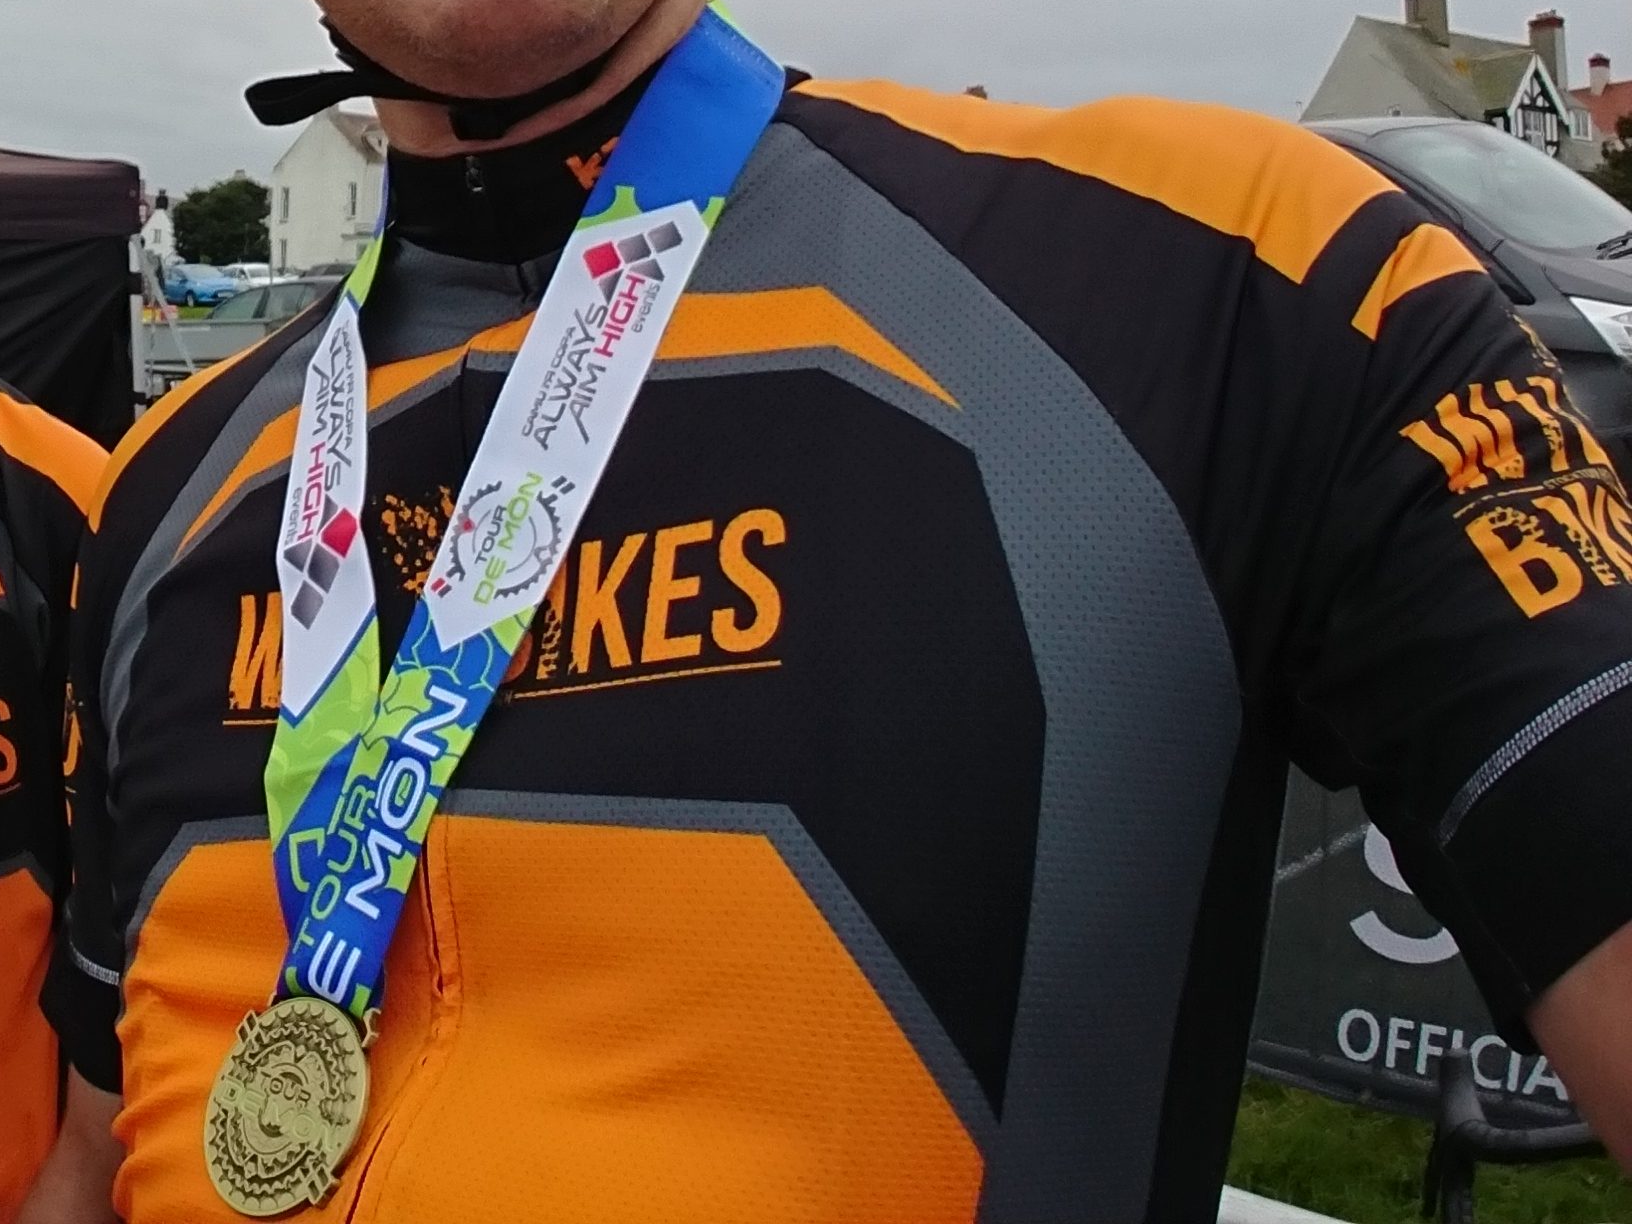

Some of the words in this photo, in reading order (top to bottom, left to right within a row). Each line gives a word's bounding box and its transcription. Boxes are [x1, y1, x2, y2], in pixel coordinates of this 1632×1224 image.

[569, 363, 607, 445] AIM
[593, 274, 646, 358] HIGH
[632, 283, 660, 333] events
[312, 363, 330, 437] AIM
[324, 327, 353, 493] ALWAYS
[534, 303, 608, 451] ALWAYS
[1398, 376, 1613, 494] WIL
[297, 441, 326, 542] HIGH
[474, 505, 507, 564] TOUR
[473, 556, 507, 604] DE
[501, 509, 786, 680] IKES
[293, 784, 375, 954] TOUR
[260, 1071, 311, 1110] TOUR
